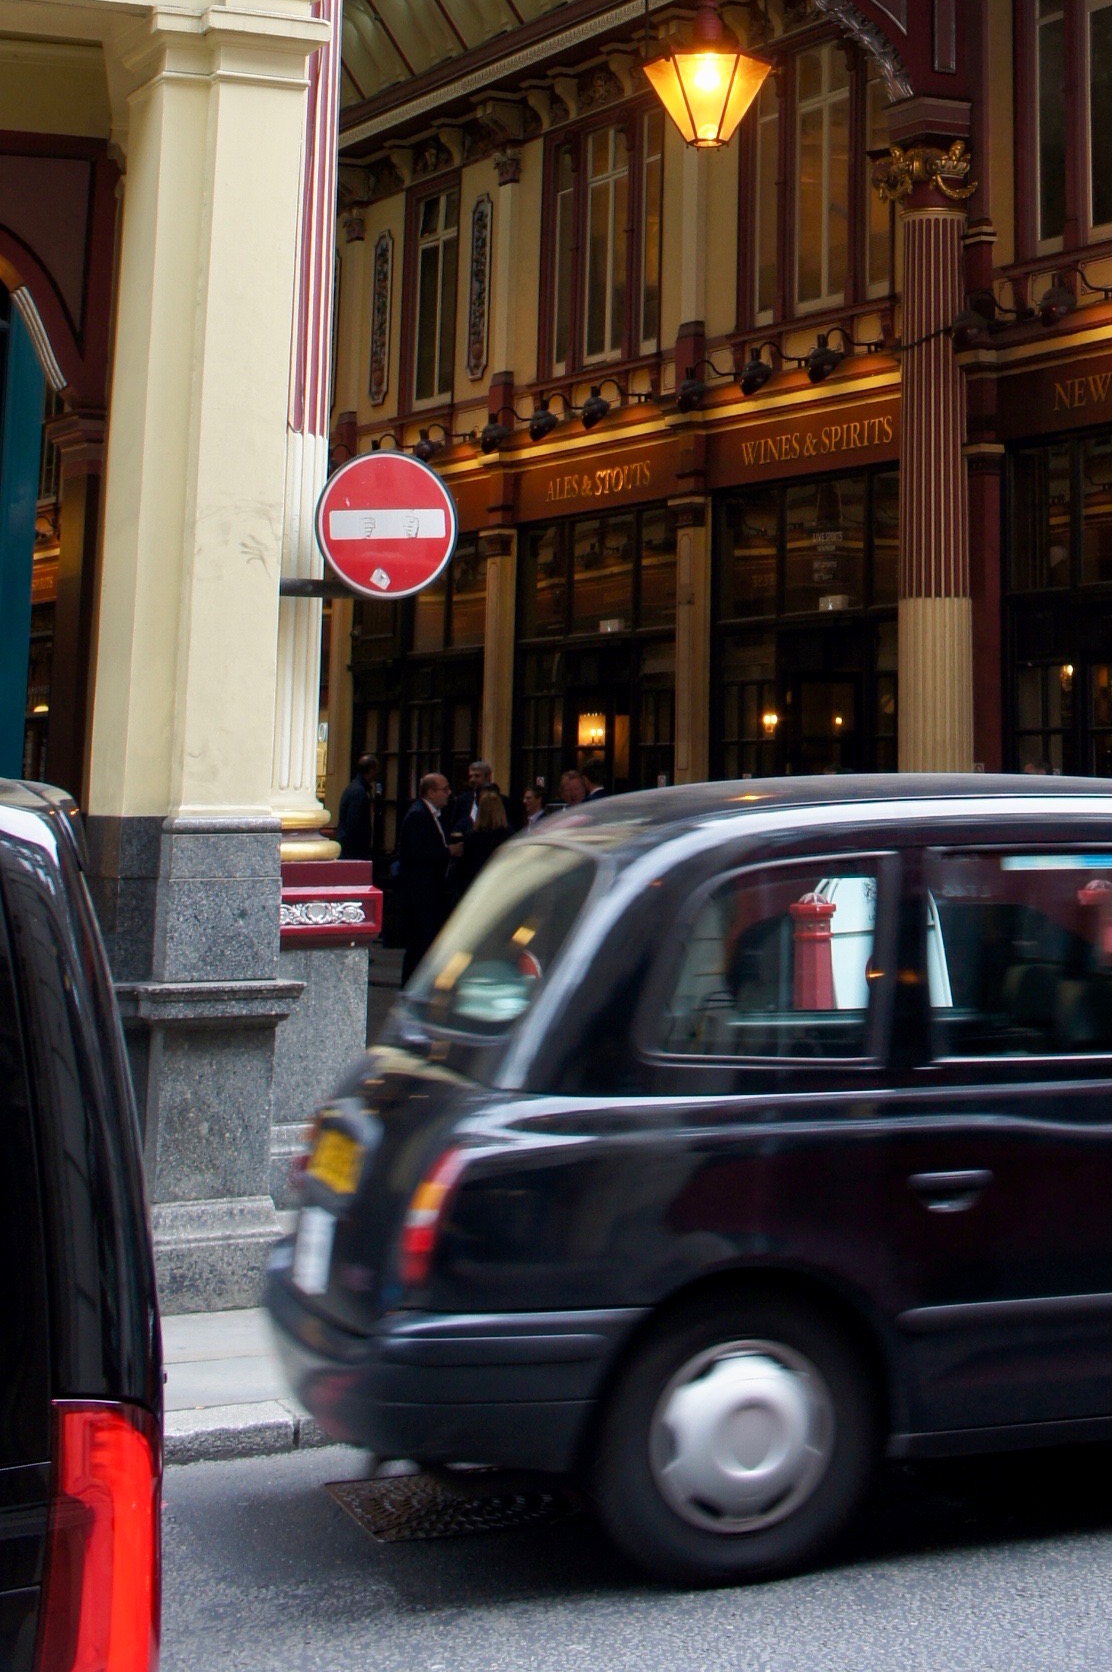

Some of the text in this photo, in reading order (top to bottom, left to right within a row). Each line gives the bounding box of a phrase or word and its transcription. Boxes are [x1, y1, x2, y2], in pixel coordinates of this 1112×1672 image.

[1052, 372, 1112, 411] NEW
[741, 415, 893, 467] WINES & SPIRITS
[545, 460, 651, 502] ALES & STOUTS
